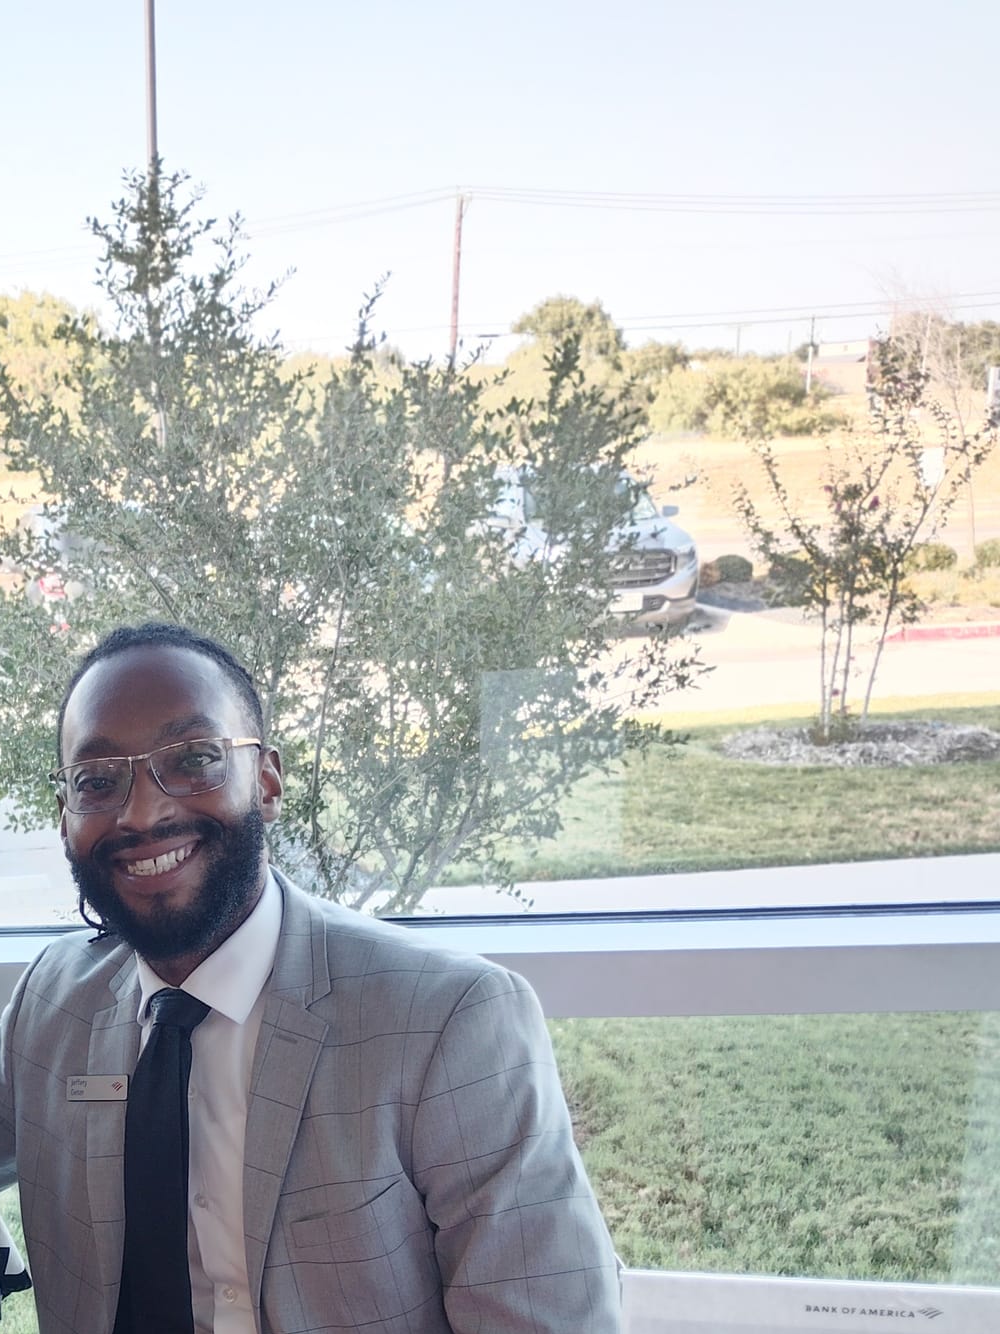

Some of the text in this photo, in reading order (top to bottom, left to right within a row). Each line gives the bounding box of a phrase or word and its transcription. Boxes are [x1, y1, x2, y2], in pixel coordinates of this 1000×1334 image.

[805, 1304, 916, 1318] BANK OF AMERICA
